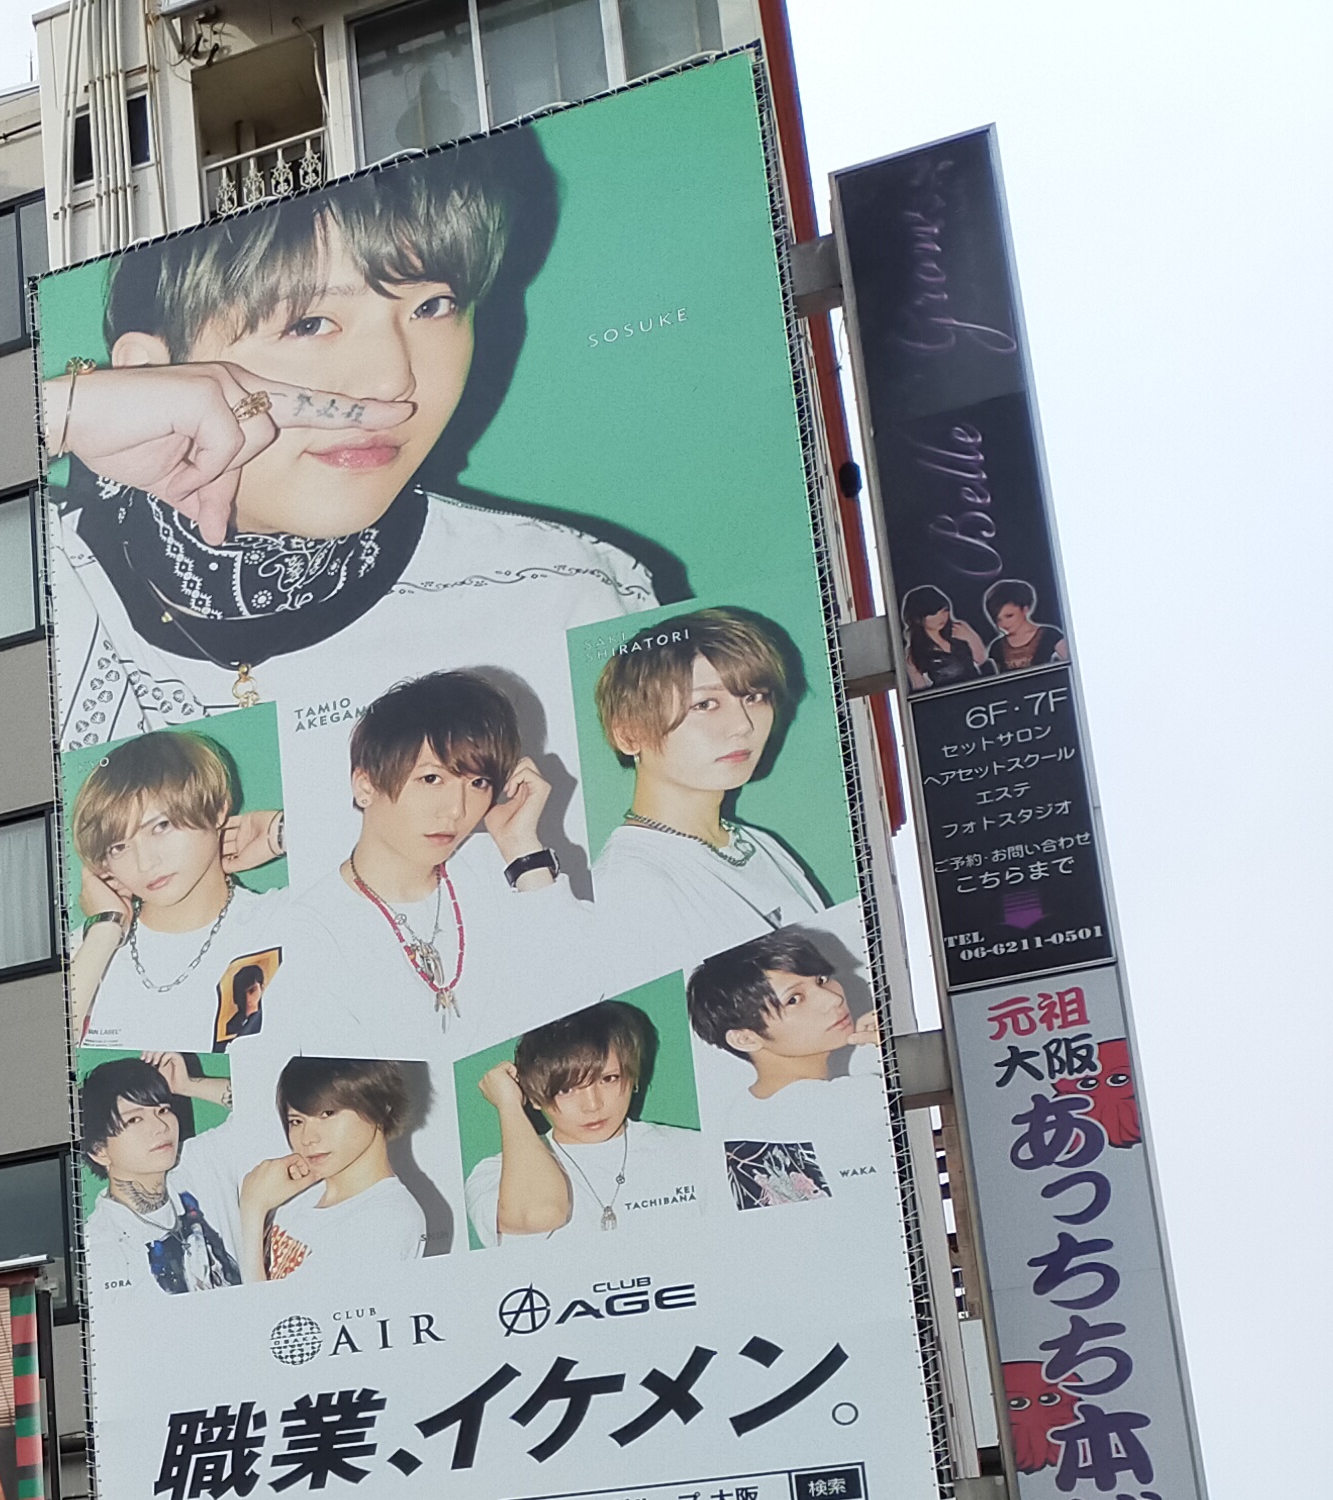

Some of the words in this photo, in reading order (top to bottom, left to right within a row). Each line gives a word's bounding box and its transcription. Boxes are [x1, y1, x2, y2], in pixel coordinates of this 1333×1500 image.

[587, 306, 690, 348] SOSUKE
[585, 628, 691, 662] SHIRATORI
[294, 697, 352, 719] TAMIO
[295, 704, 376, 732] AKEGAMI
[941, 725, 1052, 758] セットサロン
[923, 746, 1076, 786] ヘアセットスクール
[976, 781, 1032, 806] エステ
[941, 800, 1073, 838] フォトスタジオ
[956, 856, 1076, 894] こちらまで
[943, 929, 985, 949] TEL
[959, 925, 1104, 961] 06-6211-0501
[986, 986, 1091, 1041] 元祖
[994, 1032, 1102, 1089] 大阪
[838, 1164, 878, 1178] WAKA
[624, 1193, 698, 1211] TACHIBANA
[675, 1185, 696, 1196] KEI
[104, 1279, 133, 1290] SORA
[592, 1276, 652, 1293] CLUB
[332, 1307, 378, 1321] CLUB
[554, 1282, 698, 1323] AGE
[328, 1313, 446, 1357] AIR
[807, 1476, 848, 1498] 検索
